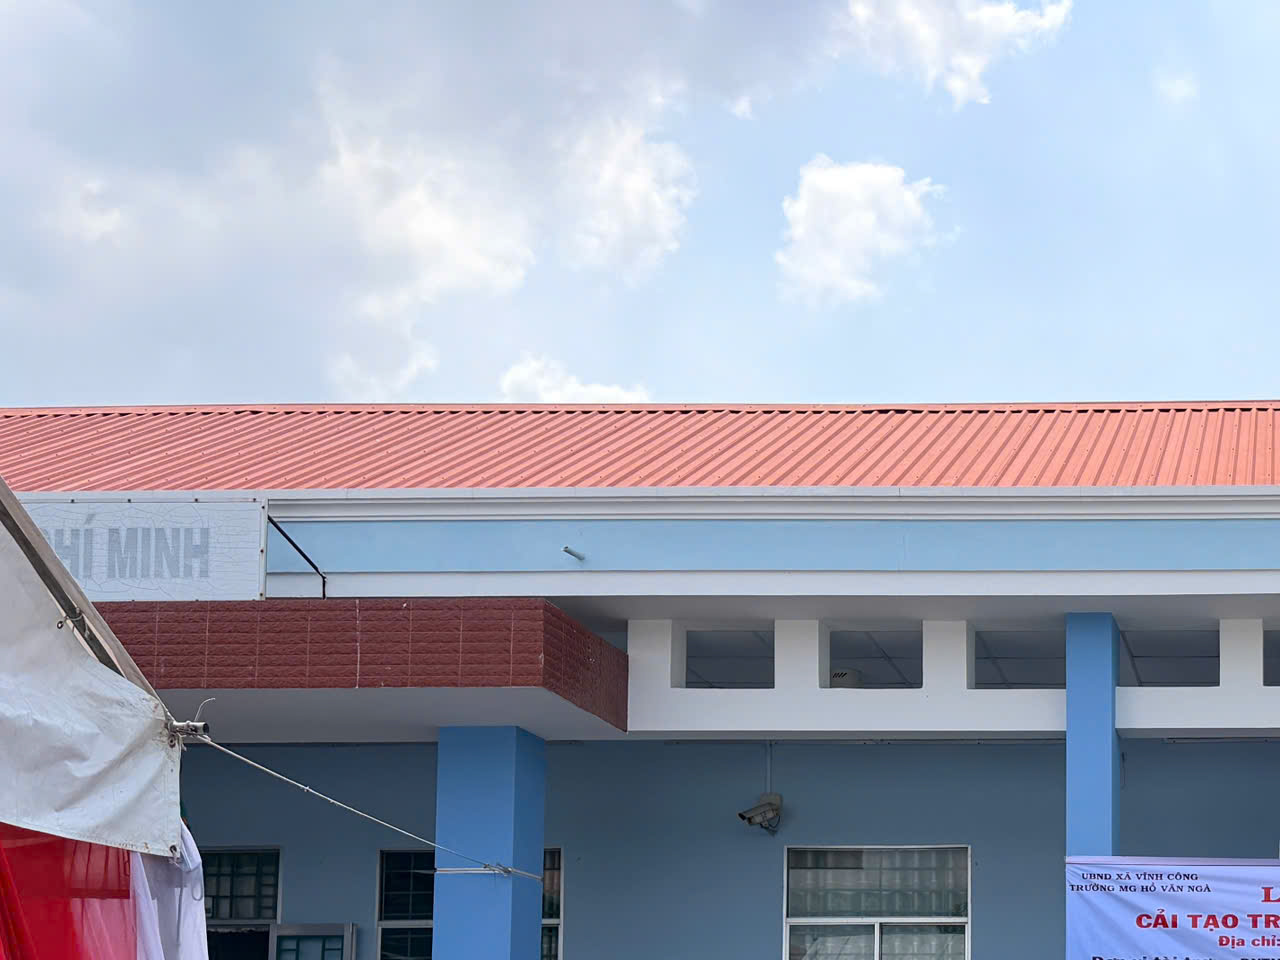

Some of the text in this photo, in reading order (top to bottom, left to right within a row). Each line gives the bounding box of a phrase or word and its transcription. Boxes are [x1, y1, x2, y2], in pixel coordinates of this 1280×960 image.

[44, 512, 209, 579] HÍ MINH
[1081, 871, 1199, 881] UBND XÃ VĨNH CÔNG
[1068, 882, 1115, 894] TRƯỜNG
[1118, 884, 1138, 893] MG
[1160, 883, 1184, 893] VĂN
[1187, 883, 1212, 893] NGÀ
[1135, 908, 1179, 929] CẢI
[1186, 913, 1240, 932] TẠO
[1217, 935, 1246, 950] Địa
